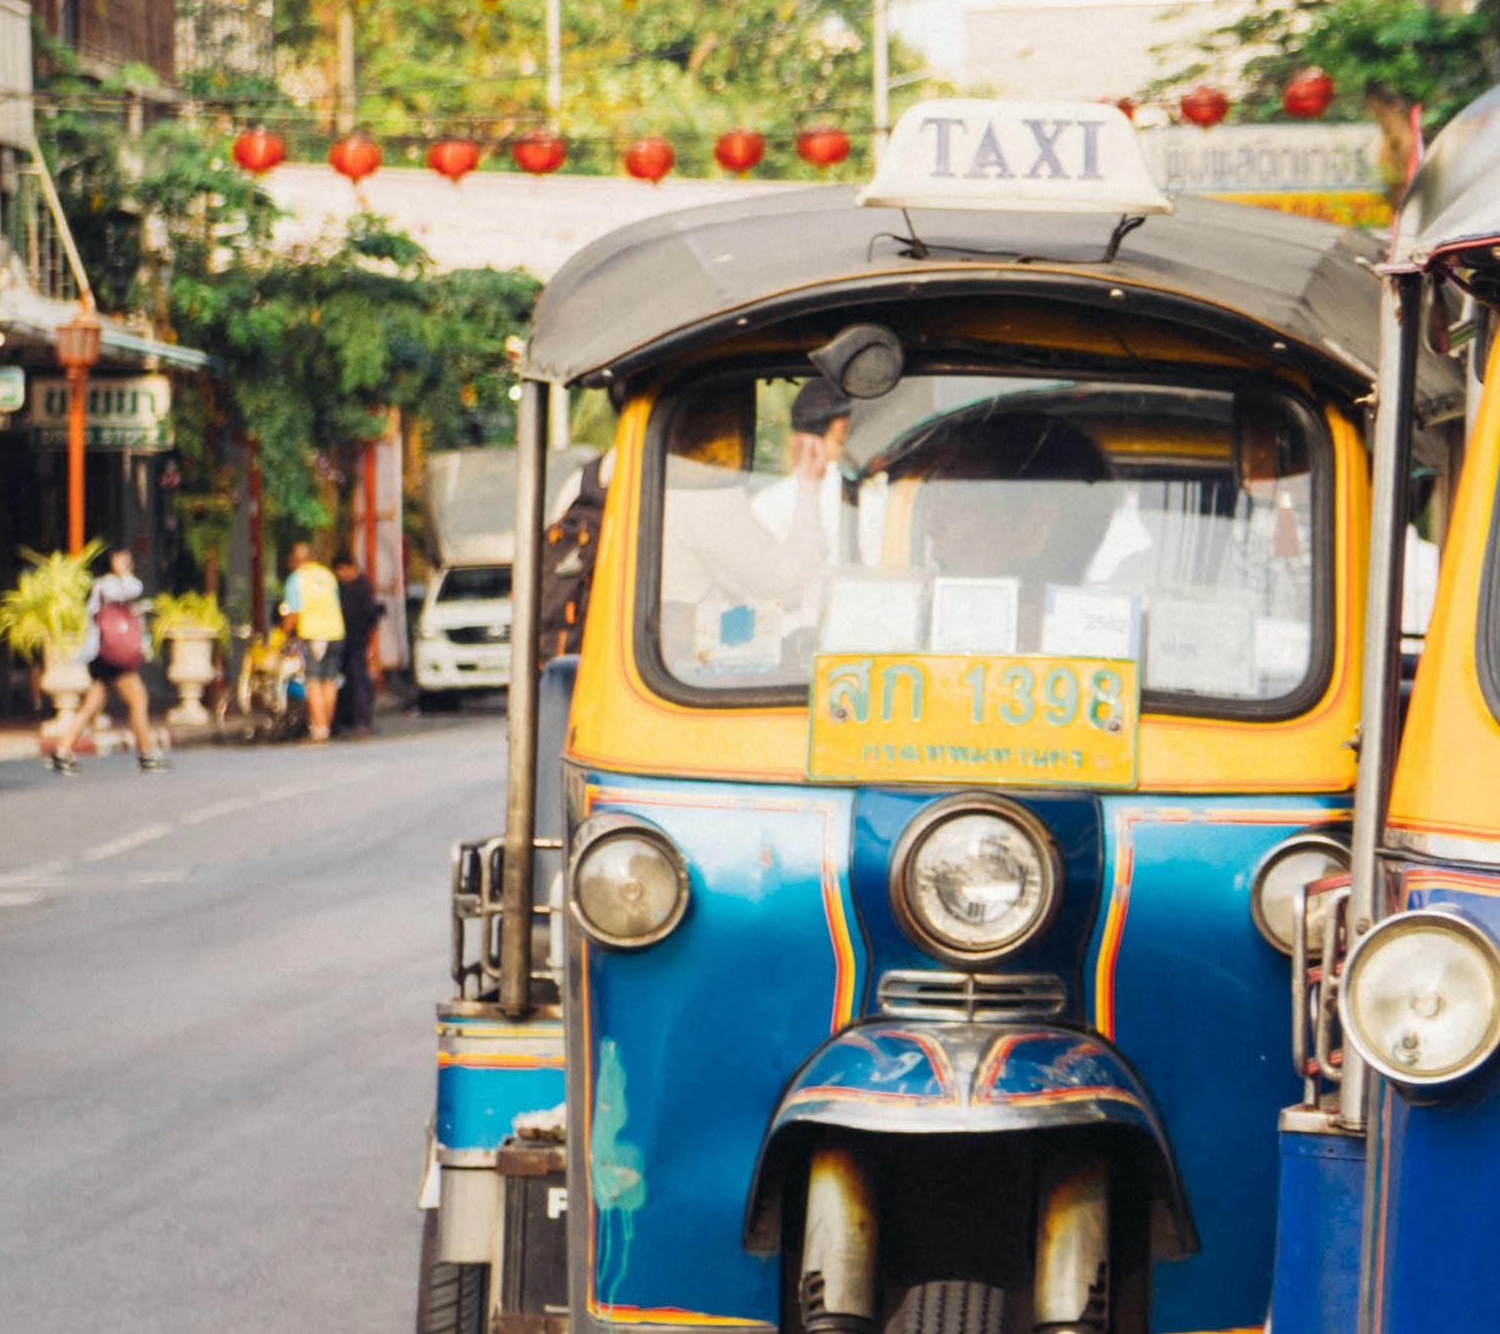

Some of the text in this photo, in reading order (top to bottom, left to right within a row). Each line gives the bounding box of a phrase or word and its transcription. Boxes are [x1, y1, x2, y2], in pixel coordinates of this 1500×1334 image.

[919, 116, 1106, 180] TAXI
[45, 388, 156, 415] ขยยา
[964, 662, 1124, 732] 1398
